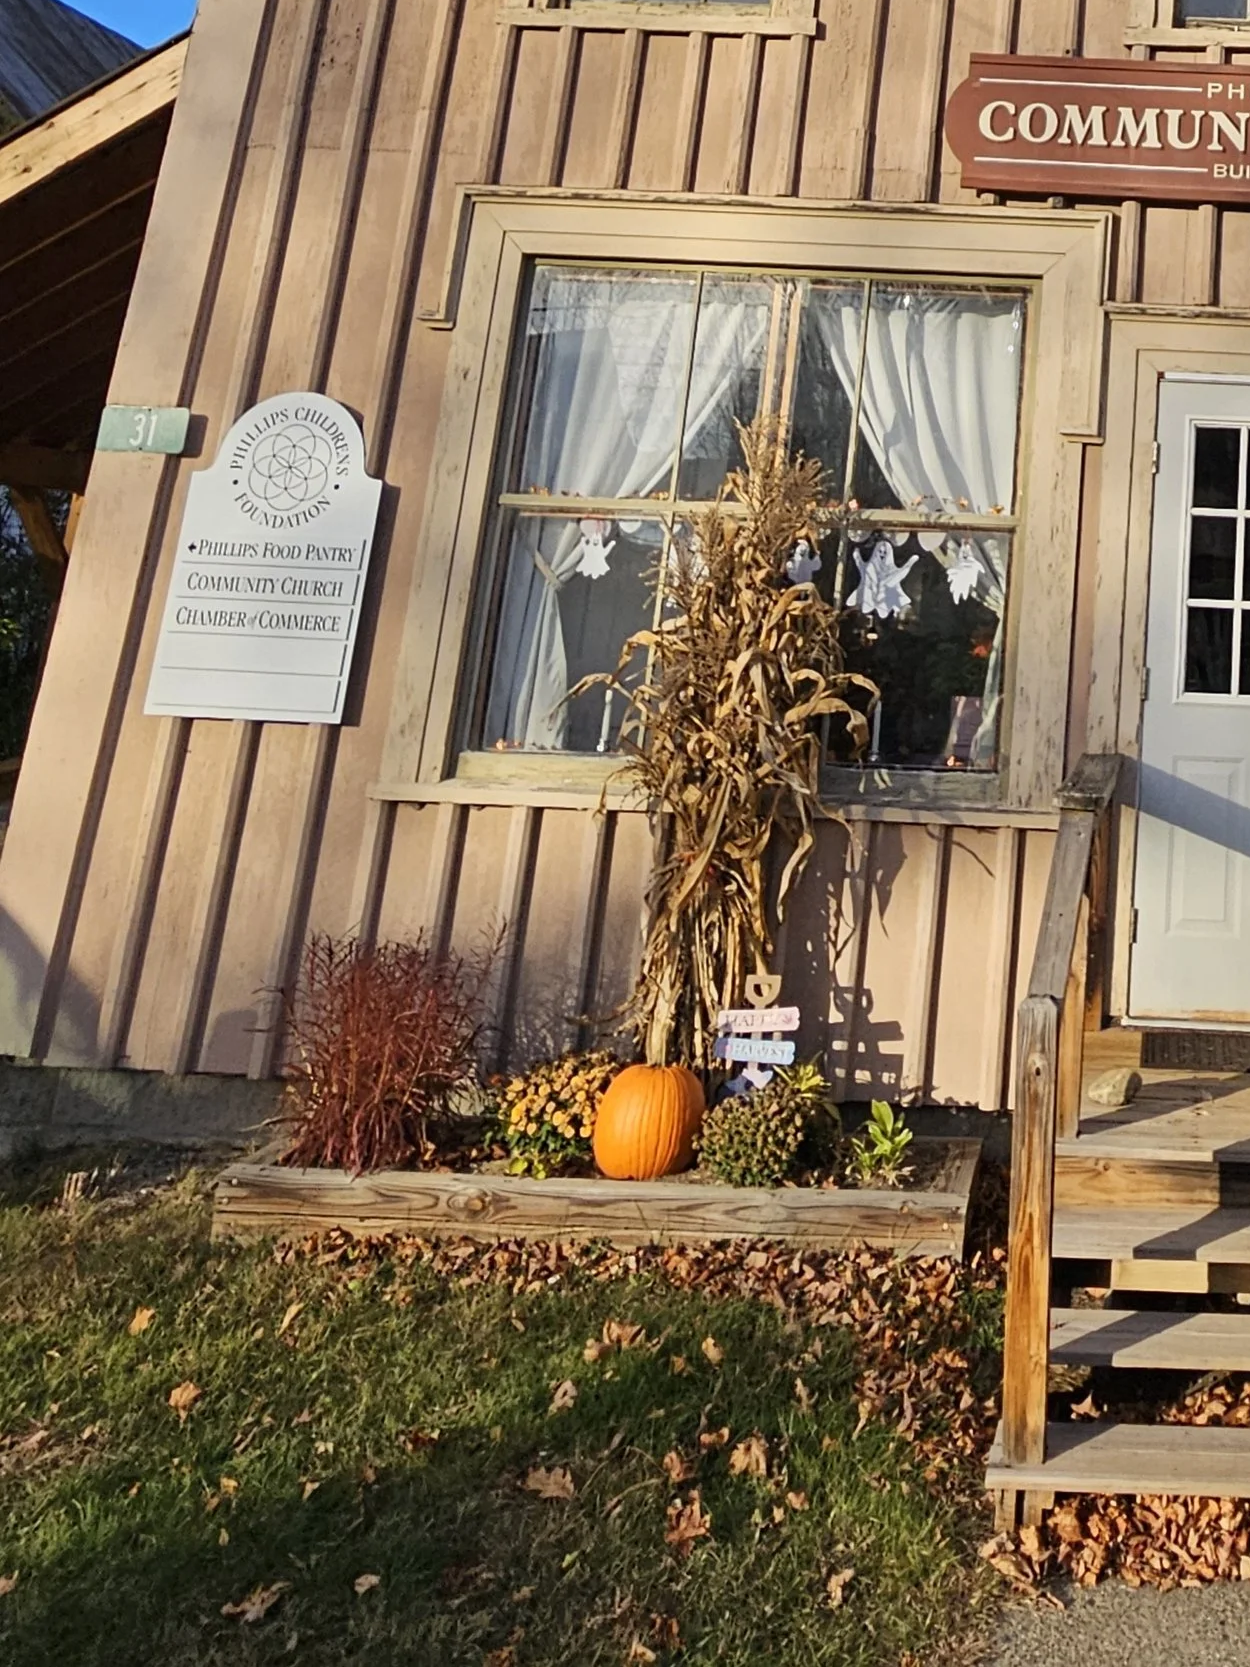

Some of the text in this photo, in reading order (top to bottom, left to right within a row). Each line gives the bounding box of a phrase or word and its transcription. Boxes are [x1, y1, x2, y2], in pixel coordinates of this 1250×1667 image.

[128, 413, 158, 447] 31
[229, 406, 351, 477] PHILLIPS CHILDRENS
[234, 492, 331, 529] FOUNDATION
[198, 538, 357, 563] PHILLIPS FOOD PANTRY
[187, 571, 344, 598] COMMUNITY CHURCH
[176, 605, 247, 628] CHAMBER
[258, 609, 342, 633] COMMERCE
